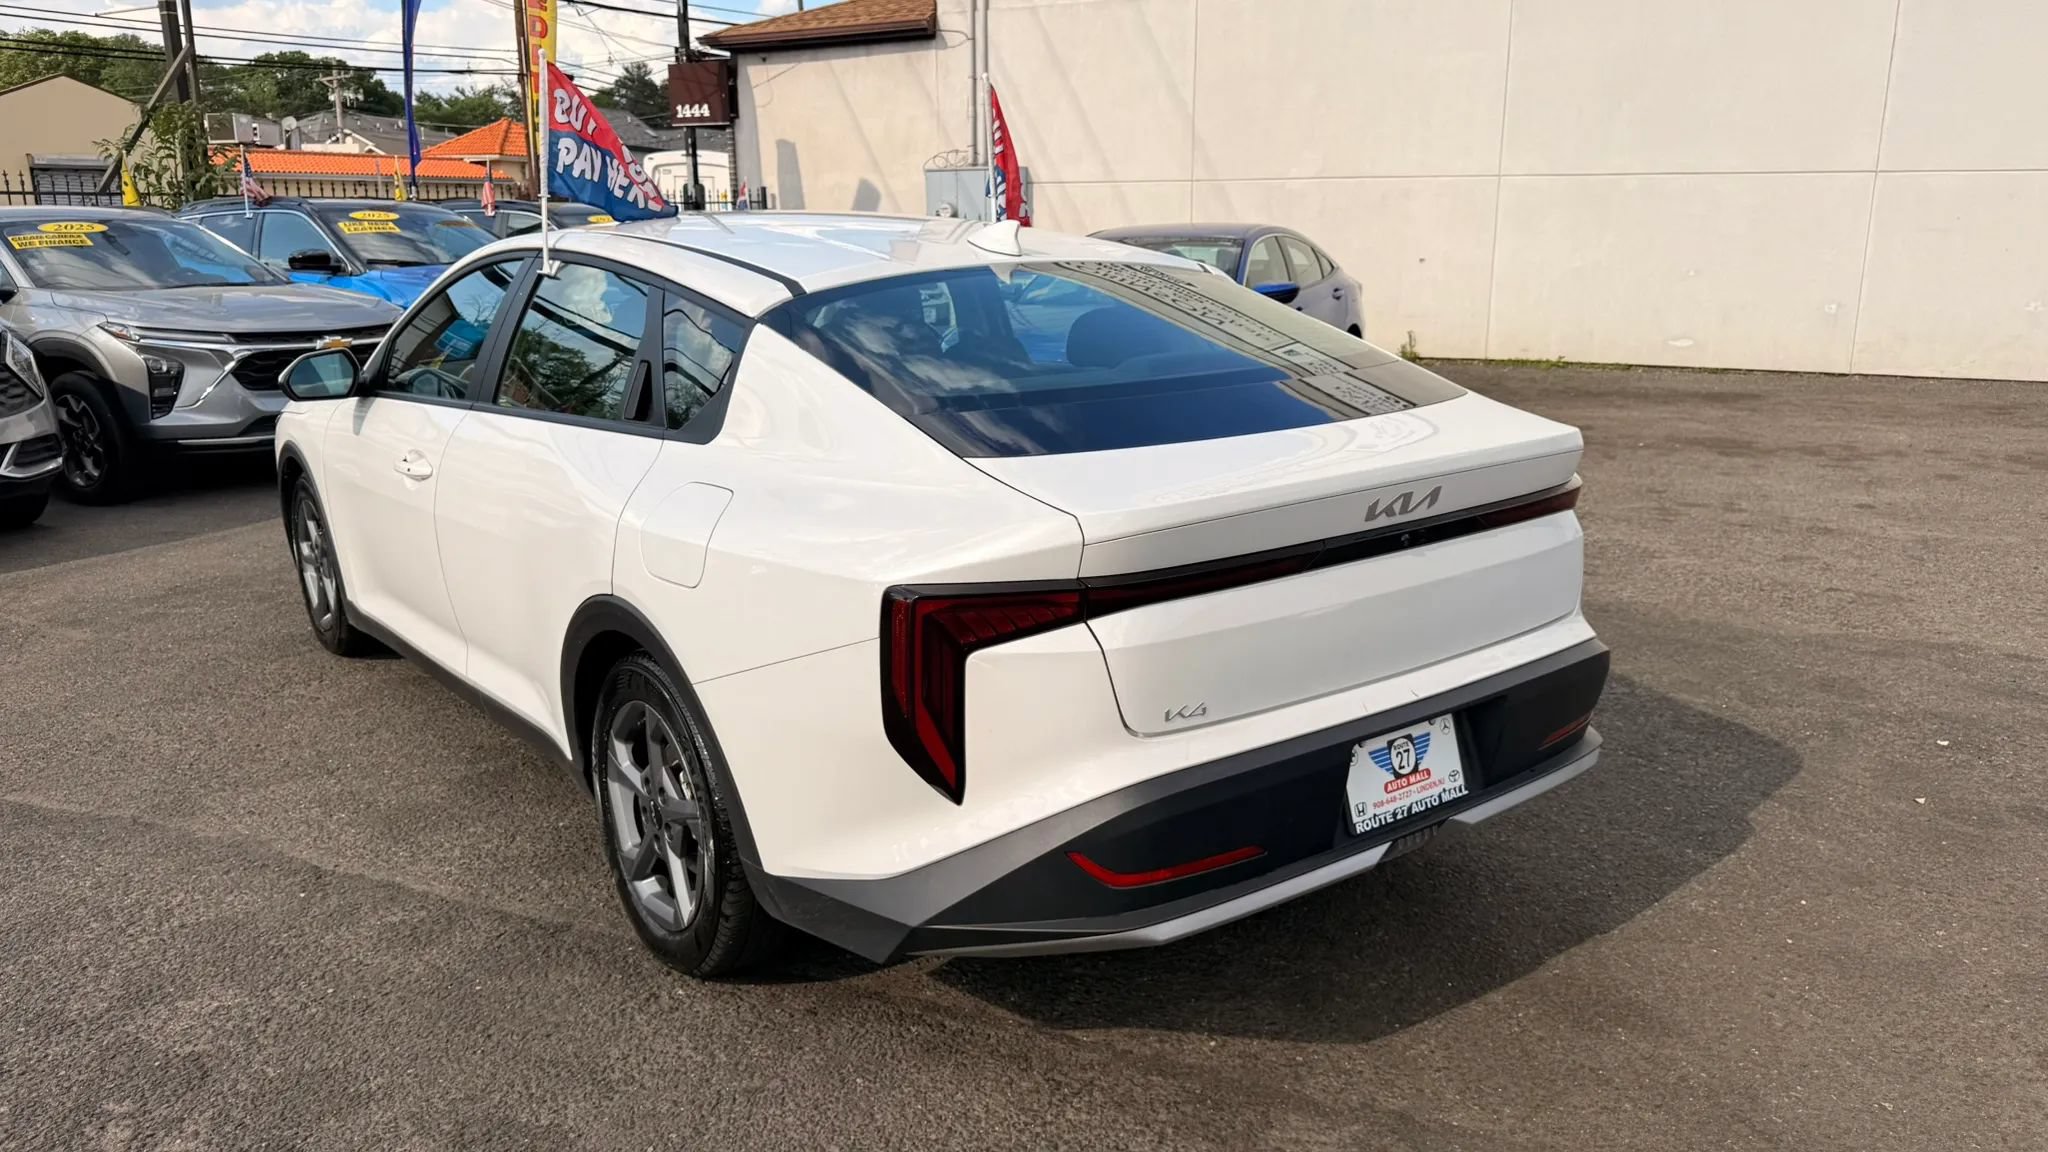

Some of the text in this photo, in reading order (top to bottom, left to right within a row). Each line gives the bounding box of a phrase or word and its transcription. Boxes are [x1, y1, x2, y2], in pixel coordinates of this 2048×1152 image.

[675, 103, 711, 118] 1444
[556, 137, 602, 183] PAY
[53, 223, 96, 231] 2025
[17, 240, 38, 248] WE
[1364, 485, 1443, 523] KIA
[1164, 701, 1207, 723] K4
[1393, 741, 1410, 751] ROUTE
[1395, 748, 1411, 771] 27
[1386, 771, 1429, 792] AUTO MALL
[1355, 783, 1469, 834] ROUTE 27 AUTO MALL
